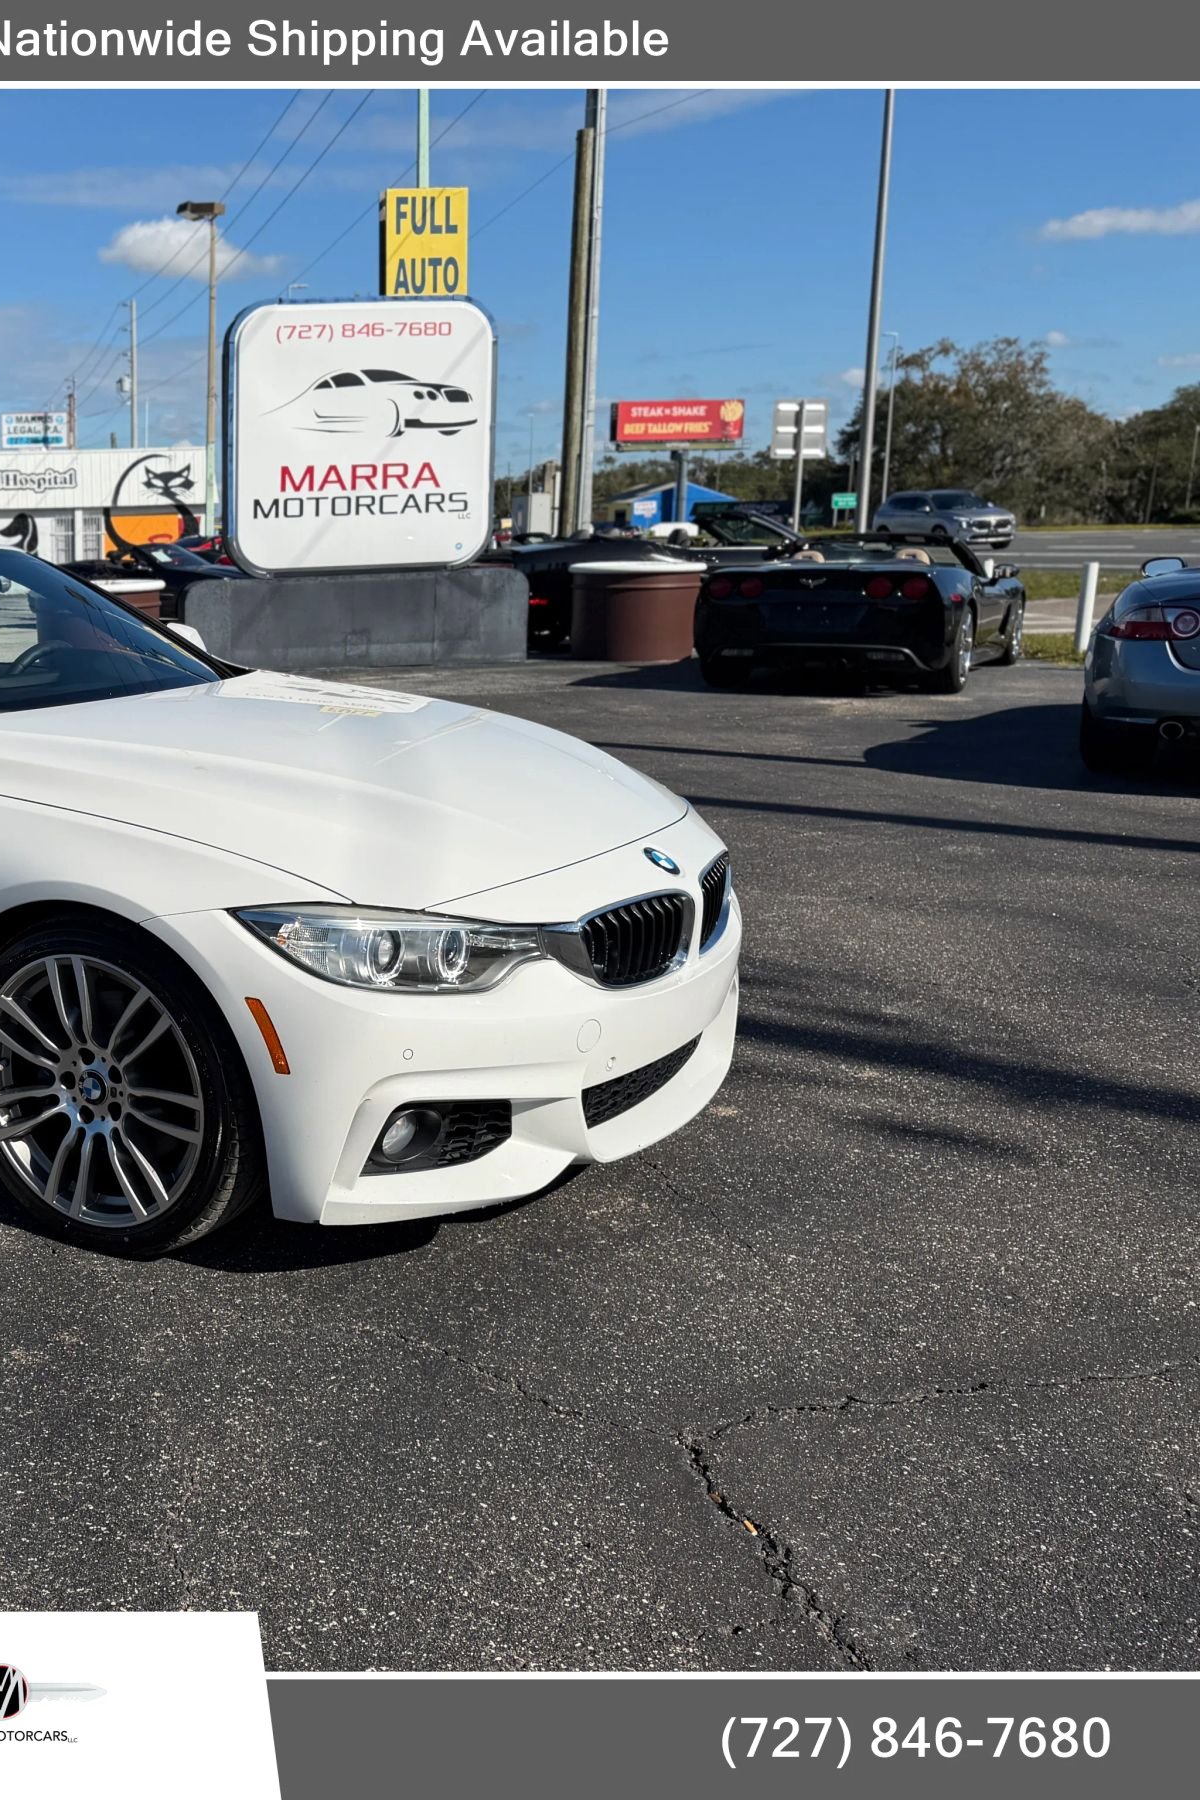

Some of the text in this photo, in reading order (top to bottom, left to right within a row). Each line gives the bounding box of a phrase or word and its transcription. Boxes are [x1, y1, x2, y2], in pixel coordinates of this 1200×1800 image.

[395, 196, 458, 235] FULL
[394, 256, 459, 294] AUTO
[275, 322, 452, 344] (727) 846-7680
[630, 406, 663, 418] STEAK
[671, 406, 707, 417] SHAKE
[624, 423, 646, 435] BEEF
[647, 423, 683, 434] TALLOW
[4, 472, 75, 490] Hospital
[279, 462, 441, 493] MARRA
[253, 491, 468, 519] MOTORCARS
